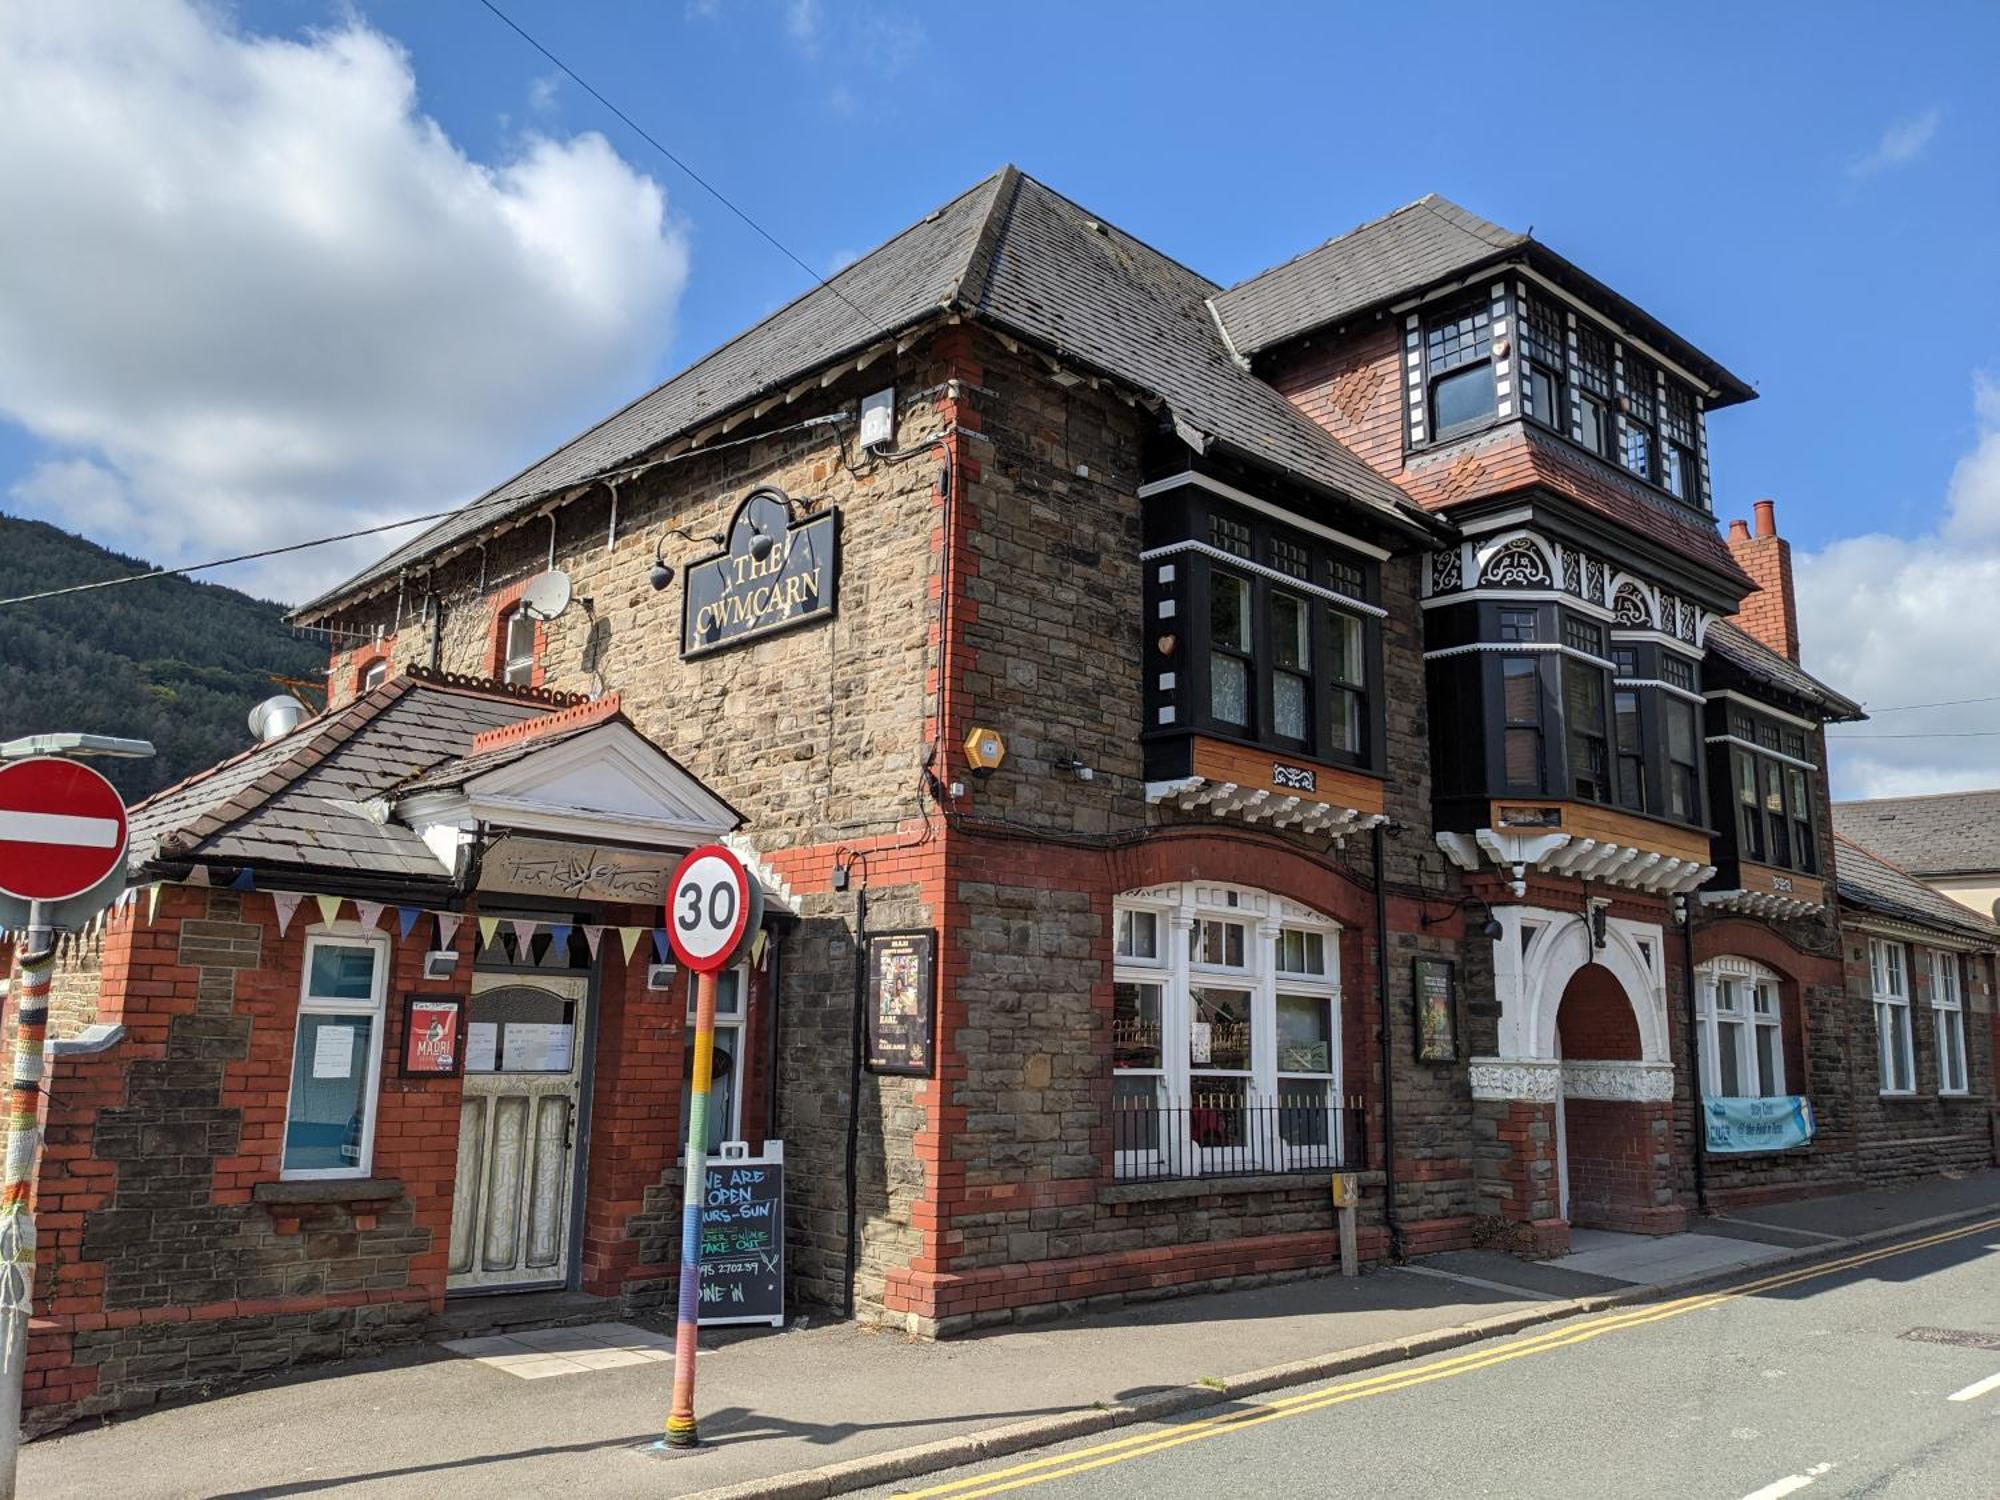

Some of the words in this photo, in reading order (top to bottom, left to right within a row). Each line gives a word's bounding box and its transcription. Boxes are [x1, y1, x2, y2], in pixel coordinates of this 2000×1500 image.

[733, 541, 783, 585] THE
[695, 567, 821, 635] CWMCARN
[678, 881, 736, 931] 30
[730, 1169, 766, 1186] ARE
[708, 1186, 752, 1206] OPEN
[703, 1202, 770, 1223] URS-SUN
[736, 1239, 761, 1250] OUT
[698, 1264, 716, 1278] 95
